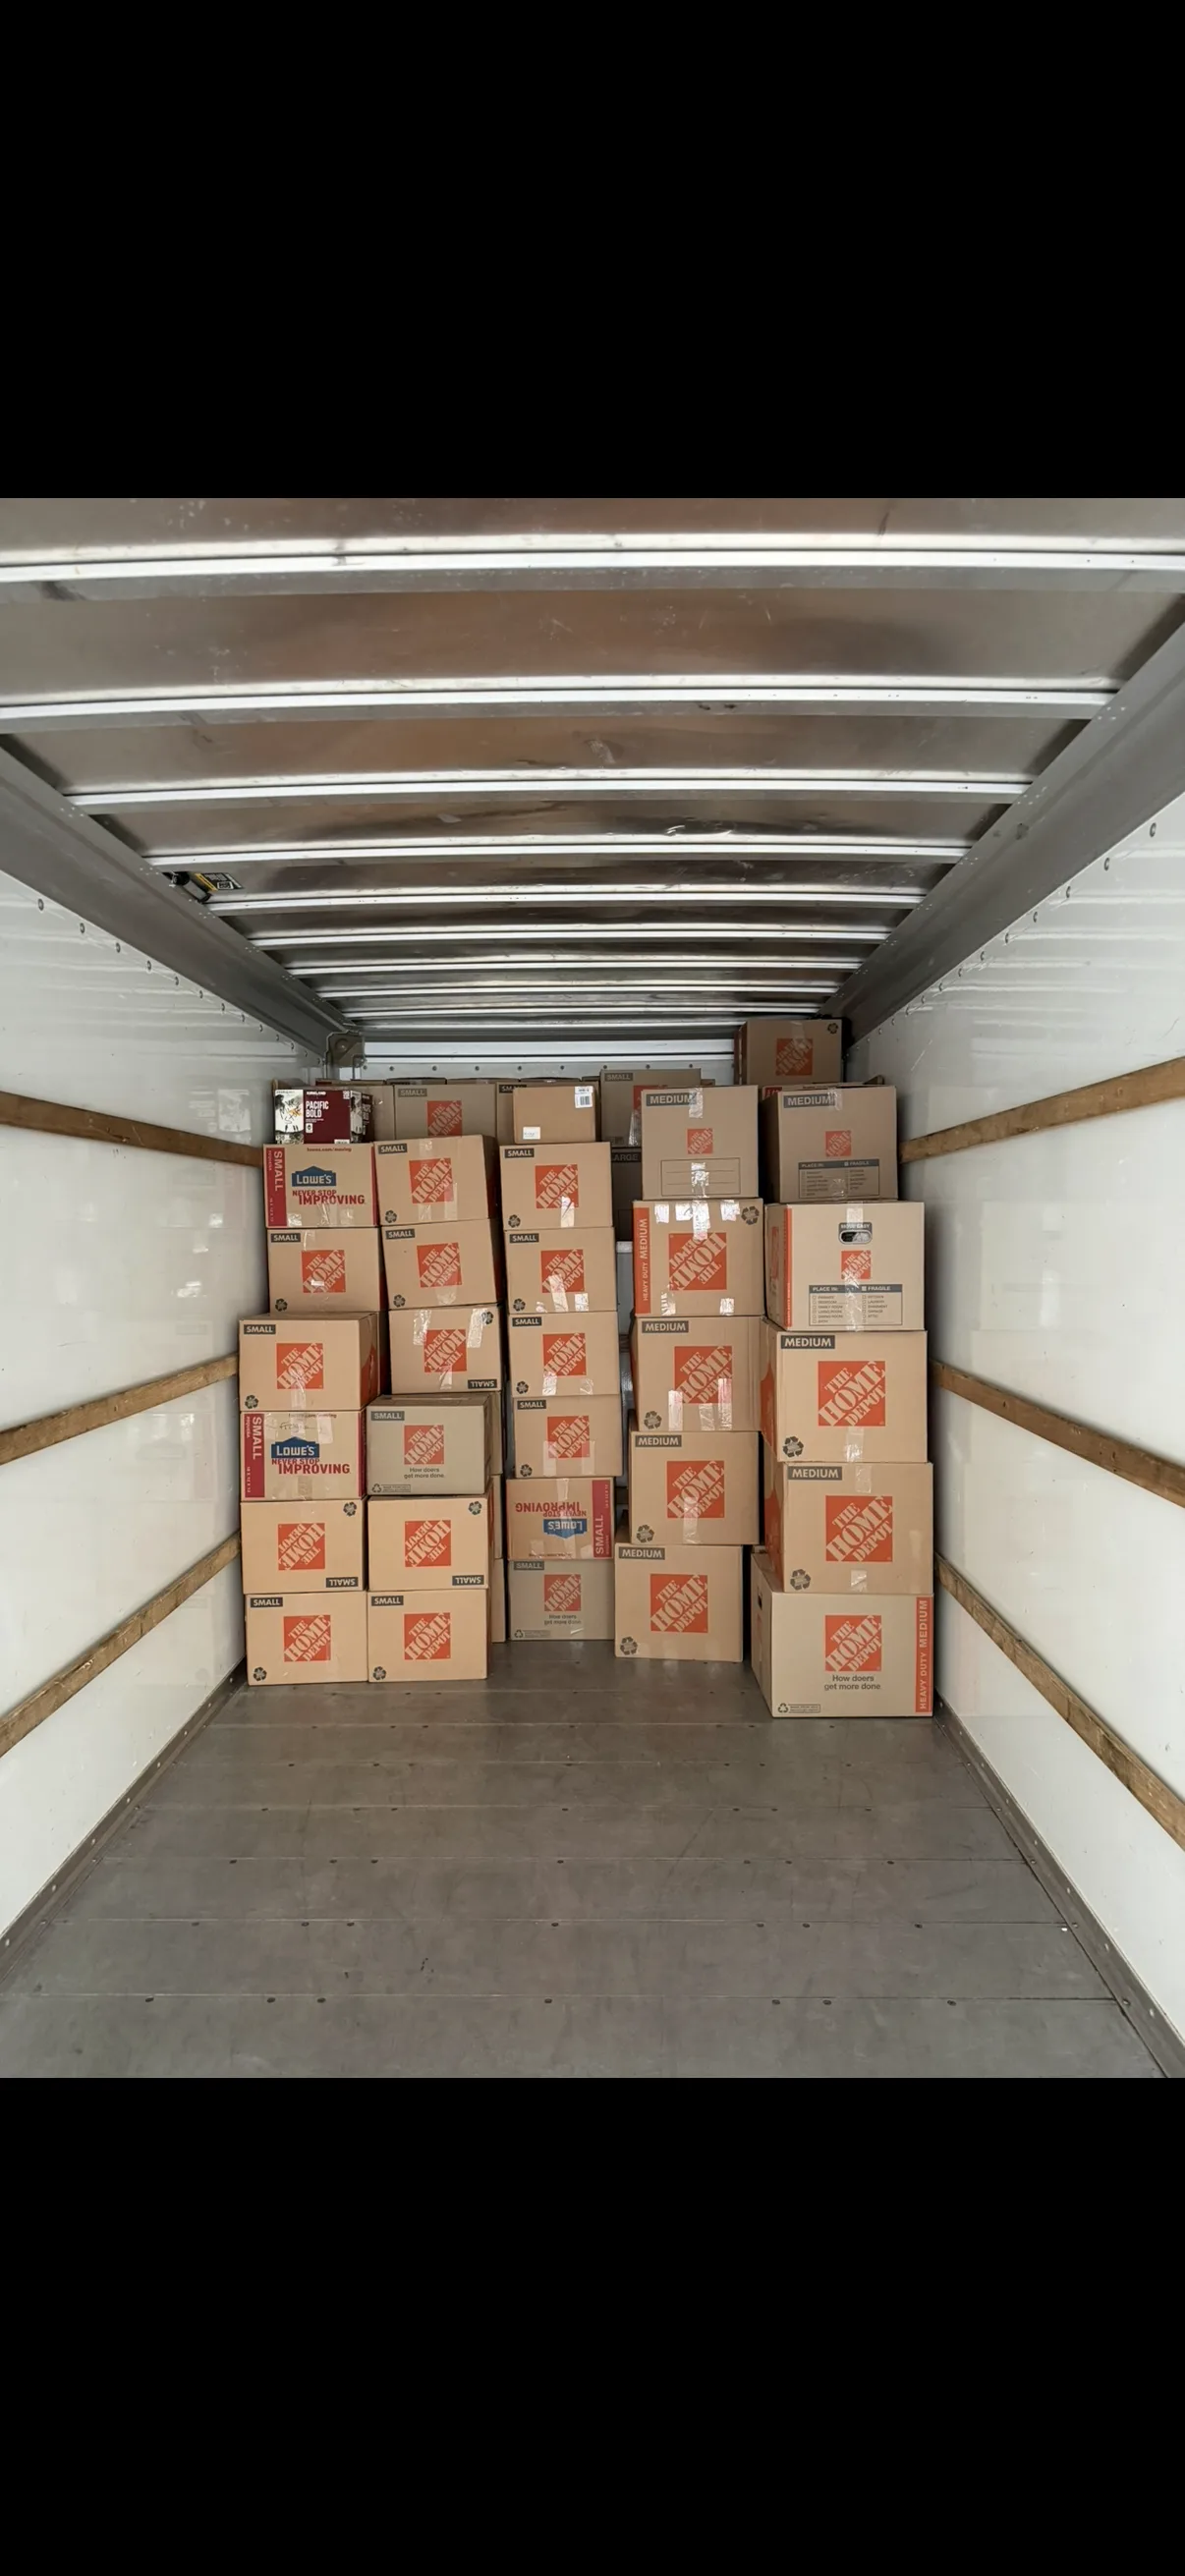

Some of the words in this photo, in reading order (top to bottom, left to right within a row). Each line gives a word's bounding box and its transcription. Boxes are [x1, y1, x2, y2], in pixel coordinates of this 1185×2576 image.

[306, 1100, 329, 1110] PACIFIC
[306, 1109, 322, 1118] BOLD
[427, 1100, 462, 1137] HOME
[274, 1150, 284, 1192] SMALL
[297, 1174, 332, 1184] LOWE'S
[409, 1158, 452, 1204] HOME
[413, 1163, 431, 1182] THE
[538, 1169, 557, 1187] THE
[299, 1195, 366, 1205] IMPROVING
[425, 1175, 452, 1204] DEPOT
[535, 1164, 578, 1208] HOME
[307, 1254, 324, 1272] THE
[417, 1243, 462, 1287] HOME
[422, 1248, 440, 1265] THE
[545, 1254, 563, 1272] THE
[668, 1233, 726, 1290] HOME
[841, 1250, 871, 1279] HOME
[302, 1250, 346, 1293] HOME
[318, 1265, 346, 1293] DEPOT
[434, 1259, 462, 1287] DEPOT
[558, 1265, 584, 1293] EPOT
[697, 1260, 720, 1284] THE
[645, 1322, 686, 1331] MEDIUM
[424, 1329, 450, 1357] DEPOT
[424, 1329, 467, 1372] HOME
[543, 1333, 586, 1375] HOME
[547, 1337, 565, 1355] THE
[785, 1338, 831, 1347] MEDIUM
[276, 1343, 323, 1389] HOME
[281, 1348, 301, 1367] THE
[560, 1349, 586, 1375] DEPOT
[680, 1352, 704, 1375] THE
[674, 1346, 733, 1403] HOME
[825, 1368, 853, 1395] THE
[818, 1361, 886, 1427] HOME
[844, 1384, 886, 1427] DEPOT
[252, 1417, 262, 1460] SMALL
[409, 1428, 424, 1445] THE
[547, 1416, 590, 1458] HOME
[551, 1420, 569, 1437] THE
[276, 1445, 314, 1456] LOWE'S
[405, 1425, 444, 1464] HOME
[420, 1439, 444, 1464] DEPOT
[564, 1431, 590, 1458] DEPOT
[279, 1464, 350, 1475] IMPROVING
[673, 1467, 697, 1490] THE
[792, 1469, 839, 1478] MEDIUM
[667, 1461, 725, 1518] HOME
[689, 1482, 725, 1518] DEPOT
[515, 1501, 580, 1512] IMPROVING
[832, 1502, 860, 1530] THE
[278, 1523, 308, 1552] DEPOT
[405, 1521, 433, 1550] DEPOT
[547, 1521, 583, 1531] LOWE'S
[595, 1515, 604, 1554] SMALL
[825, 1495, 893, 1562] HOME
[278, 1523, 325, 1570] HOME
[301, 1545, 320, 1565] THE
[405, 1521, 451, 1567] HOME
[427, 1543, 446, 1562] THE
[622, 1549, 662, 1558] MEDIUM
[851, 1520, 893, 1562] DEPOT
[544, 1574, 581, 1611] HOME
[548, 1578, 563, 1594] THE
[558, 1588, 581, 1611] DEPOT
[656, 1580, 680, 1604] THE
[650, 1574, 708, 1633] HOME
[672, 1596, 708, 1633] DEPOT
[284, 1615, 330, 1661] HOME
[289, 1620, 308, 1639] THE
[404, 1613, 450, 1659] HOME
[409, 1618, 427, 1637] THE
[831, 1622, 854, 1645] THE
[302, 1632, 330, 1661] DEPOT
[422, 1630, 450, 1659] DEPOT
[825, 1616, 882, 1671] HOME
[847, 1636, 882, 1671] DEPOT
